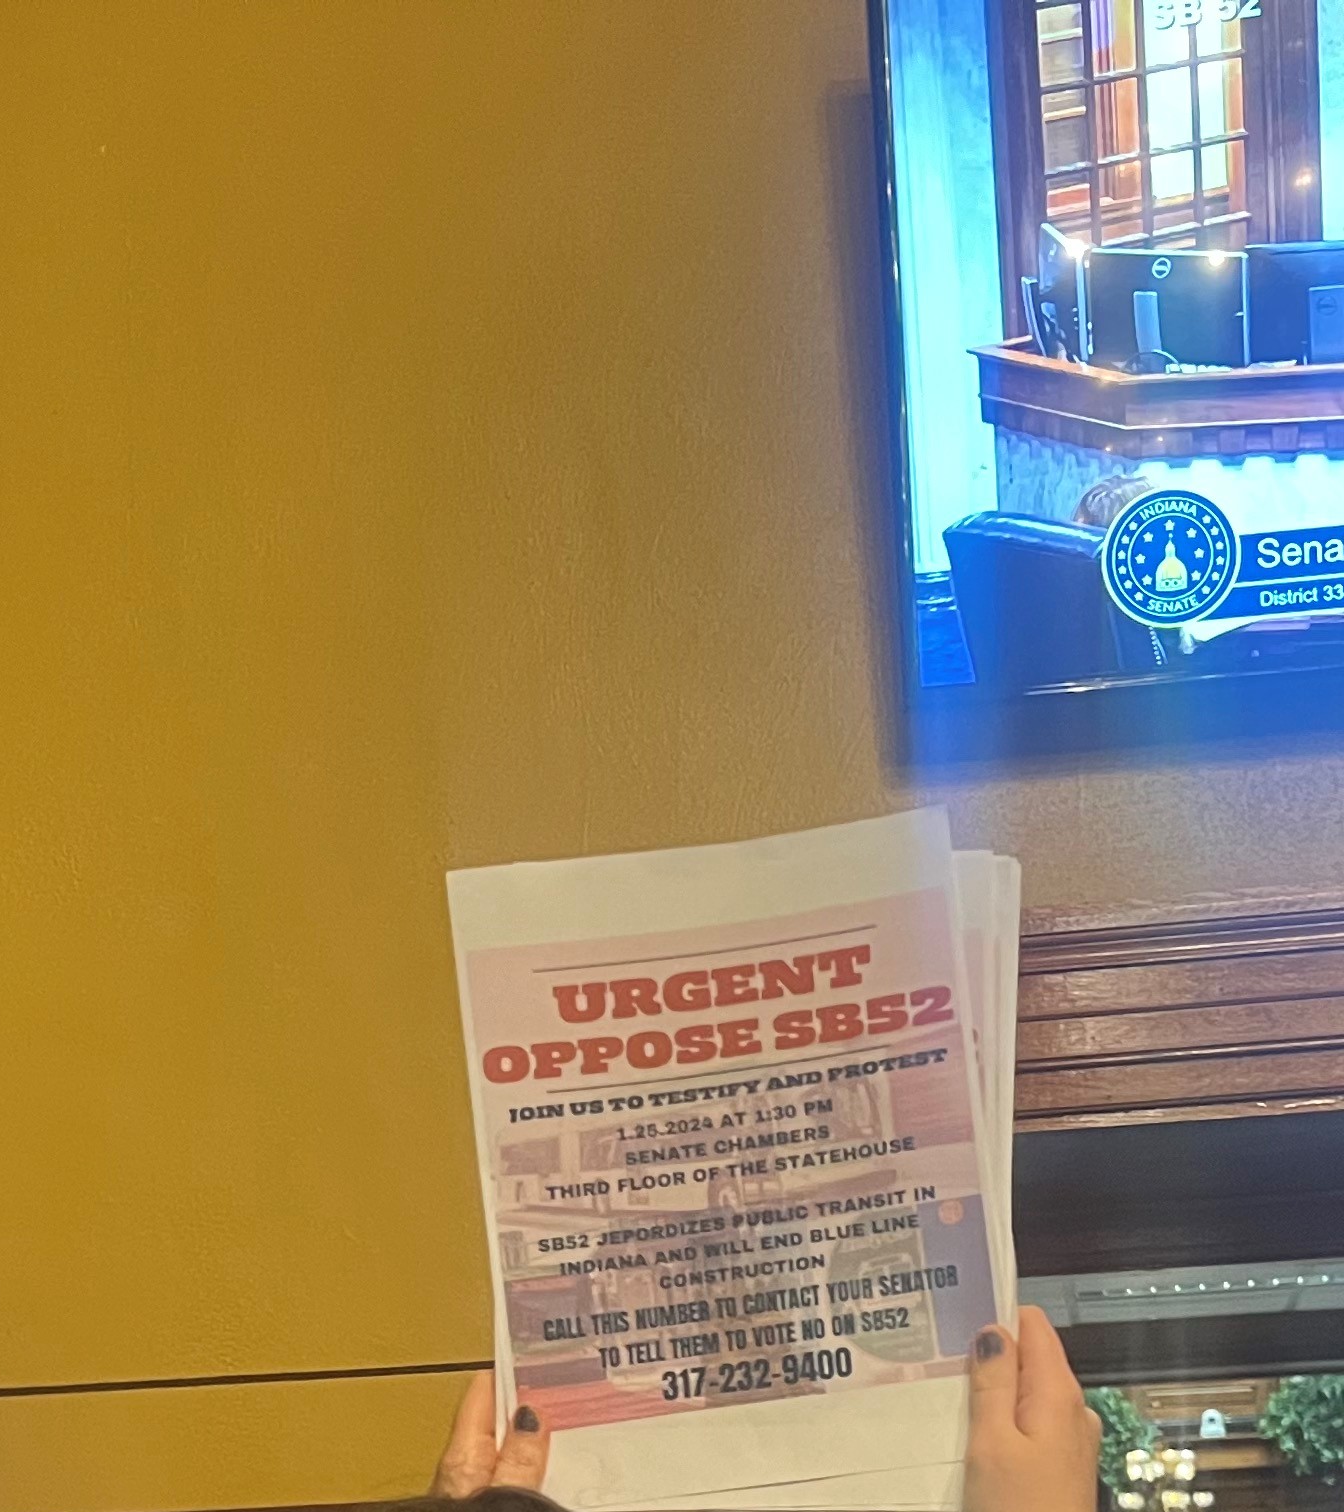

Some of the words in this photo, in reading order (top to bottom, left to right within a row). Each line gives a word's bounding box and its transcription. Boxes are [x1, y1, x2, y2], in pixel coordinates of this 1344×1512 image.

[1139, 500, 1198, 521] INDIANA
[1146, 594, 1199, 614] SENATE
[1260, 585, 1318, 608] District
[1322, 584, 1344, 601] 33
[552, 944, 871, 1024] URGENT
[482, 1015, 761, 1085] OPPOSE
[771, 984, 955, 1050] SB52
[509, 1102, 564, 1121] JOIN
[569, 1099, 603, 1115] US
[607, 1094, 643, 1111] TO
[648, 1080, 760, 1107] TESTIFY
[766, 1069, 822, 1089] AND
[828, 1048, 947, 1080] PROTEST
[616, 1116, 713, 1140] 1.25.2024
[720, 1111, 746, 1128] AT
[755, 1104, 796, 1122] 1:30
[804, 1099, 833, 1115] PM
[625, 1144, 706, 1165] SENATE
[713, 1126, 829, 1154] CHAMBERS
[545, 1178, 610, 1199] THIRD
[617, 1171, 685, 1191] FLOOR
[692, 1166, 719, 1183] OF
[728, 1160, 767, 1178] THE
[774, 1137, 915, 1171] STATEHOUSE
[538, 1234, 589, 1252] SB52
[596, 1215, 724, 1245] JEPORDIZES
[732, 1206, 808, 1228] PUBLIC
[815, 1191, 907, 1217] TRANSIT
[913, 1186, 935, 1201] IN
[559, 1253, 646, 1274] INDIANA
[654, 1246, 697, 1264] AND
[704, 1239, 753, 1259] WILL
[761, 1233, 802, 1251] END
[809, 1224, 864, 1244] BLUE
[871, 1214, 918, 1235] LINE
[659, 1255, 824, 1287] CONSTRUCTION
[543, 1319, 585, 1339] CALL
[591, 1312, 628, 1334] THIS
[635, 1304, 709, 1331] NUMBER
[716, 1298, 736, 1317] TO
[741, 1285, 820, 1314] CONTACT
[826, 1277, 872, 1302] YOUR
[878, 1265, 958, 1294] SENATOR
[599, 1347, 621, 1369] TO
[626, 1340, 665, 1365] TELL
[669, 1333, 719, 1359] THEM
[724, 1328, 746, 1349] TO
[754, 1320, 796, 1346] VOTE
[803, 1317, 825, 1339] NO
[831, 1313, 854, 1335] ON
[860, 1307, 909, 1331] SB52
[661, 1347, 853, 1401] 317-232-9400
